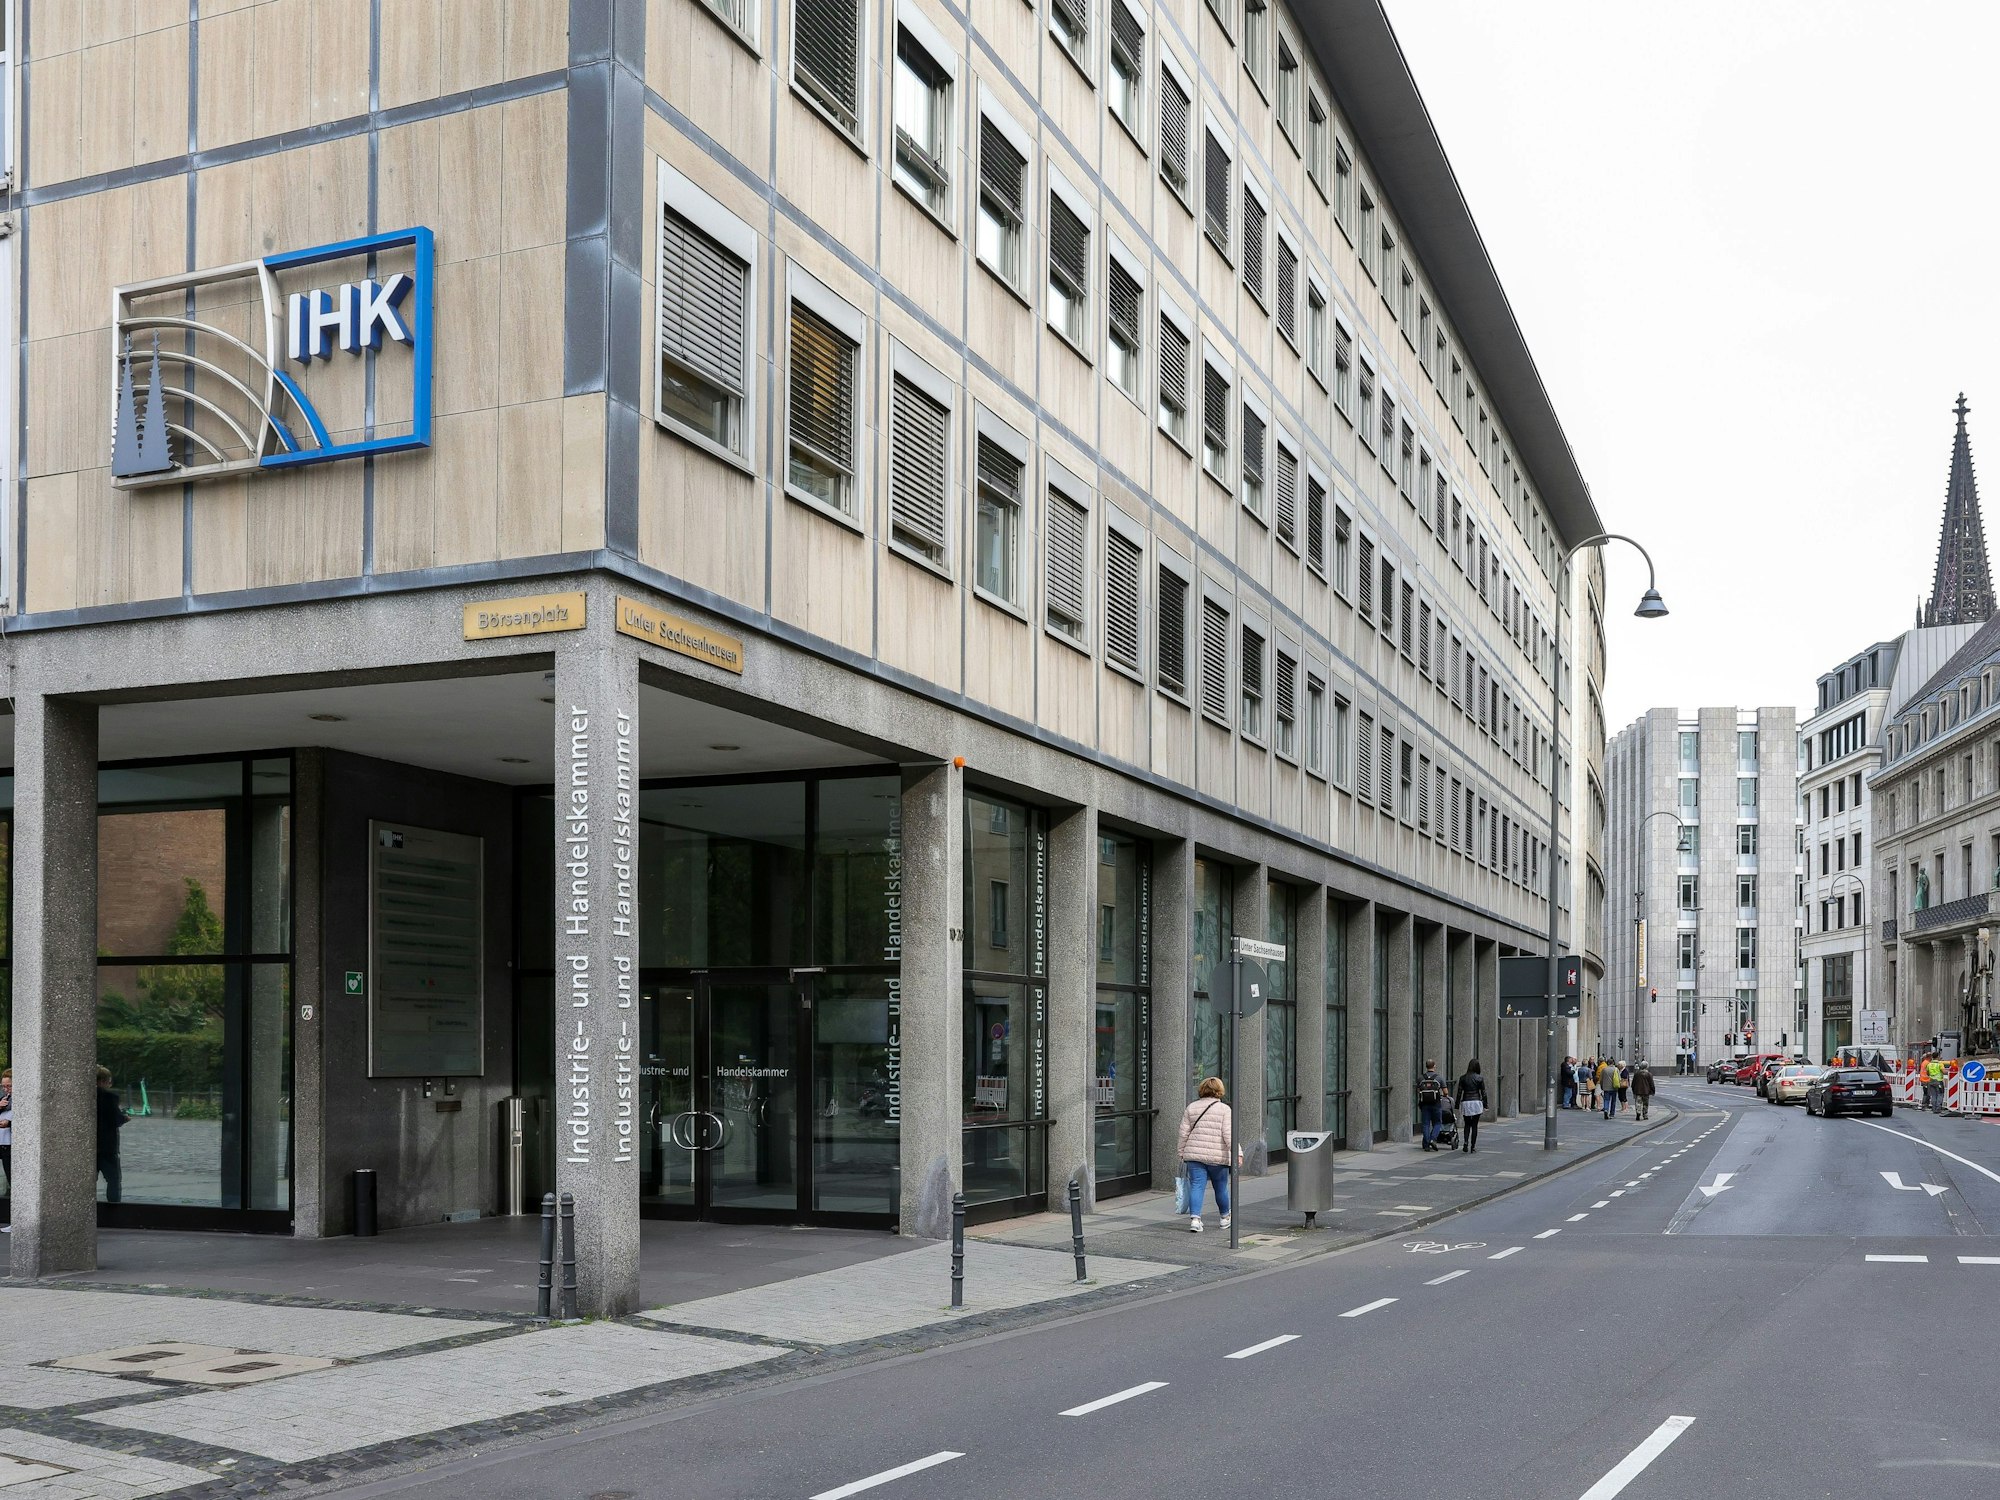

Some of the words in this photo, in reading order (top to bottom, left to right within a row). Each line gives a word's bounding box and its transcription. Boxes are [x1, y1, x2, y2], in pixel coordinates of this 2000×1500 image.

[288, 273, 411, 362] IHK
[478, 604, 569, 629] Börsenplatz
[624, 607, 656, 633] Unter
[659, 621, 737, 664] Sachsenhausen
[566, 705, 589, 935] Handelskammer
[613, 708, 631, 937] Handelskammer
[884, 801, 901, 961] Handelskammer
[1034, 834, 1044, 974] Handelskammer
[566, 955, 589, 1008] und
[613, 956, 631, 1009] und
[1240, 941, 1253, 952] Unter
[1253, 944, 1284, 957] Sachsenhausen
[884, 978, 900, 1015] und
[1035, 988, 1043, 1020] und
[566, 1020, 590, 1163] Industrie-
[614, 1021, 632, 1163] Industrie-
[672, 1066, 689, 1077] und
[717, 1066, 789, 1077] Handelskammer
[884, 1024, 900, 1124] Industrie-
[1034, 1029, 1044, 1116] Industrie-
[1140, 1029, 1148, 1106] Industrie-
